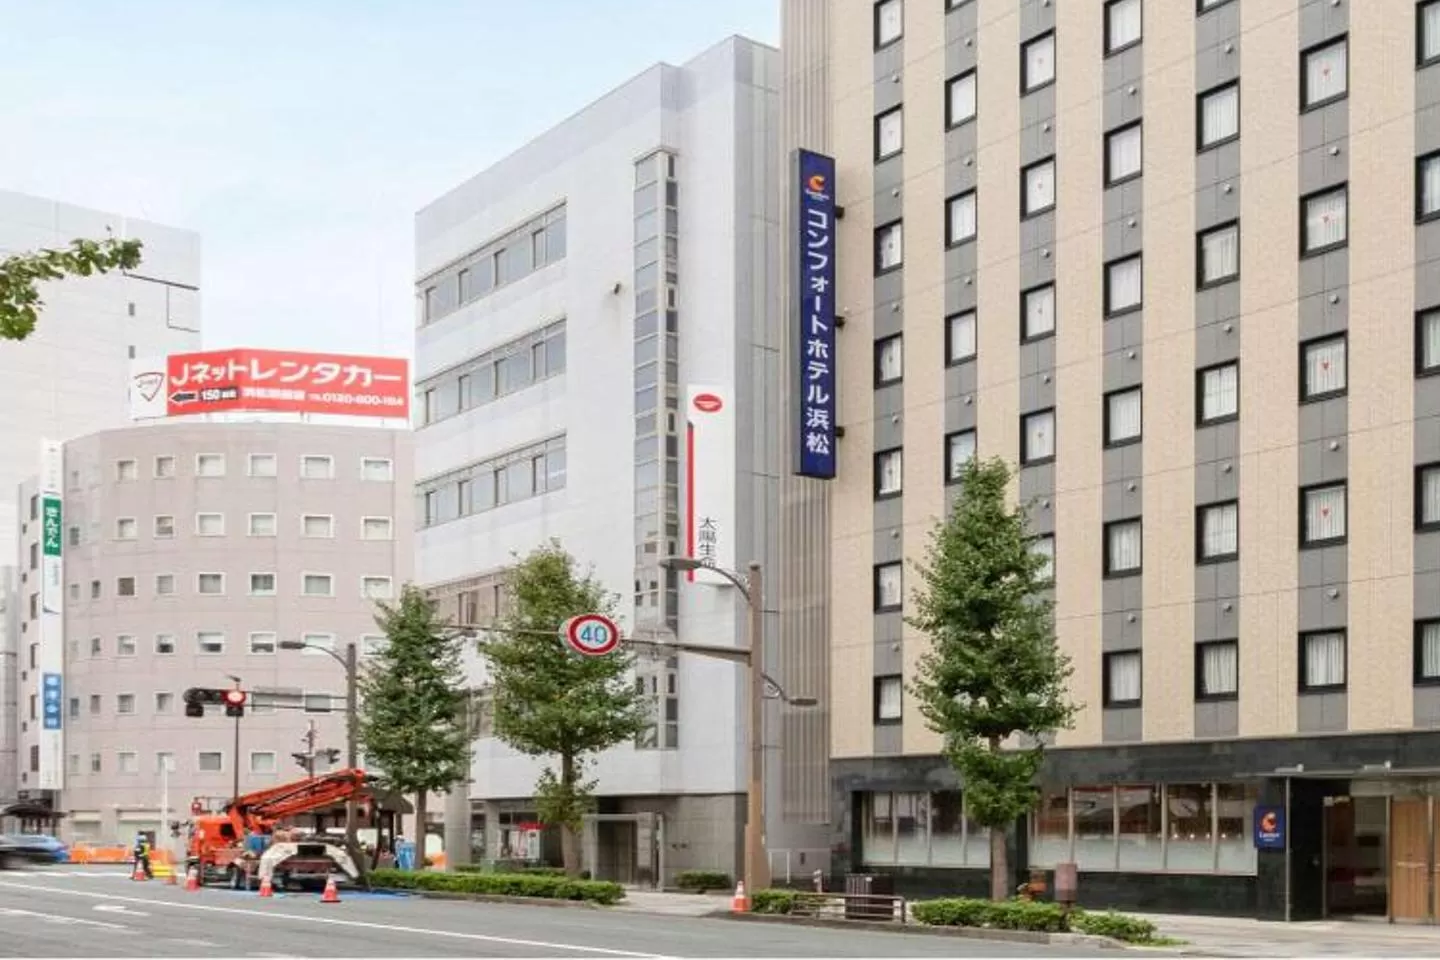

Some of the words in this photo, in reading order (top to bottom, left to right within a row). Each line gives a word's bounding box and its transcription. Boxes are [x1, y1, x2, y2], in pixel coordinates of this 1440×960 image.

[806, 207, 831, 456] コンフォートホテル浜松
[170, 357, 403, 388] Jネットレンタカー
[580, 626, 608, 644] 40
